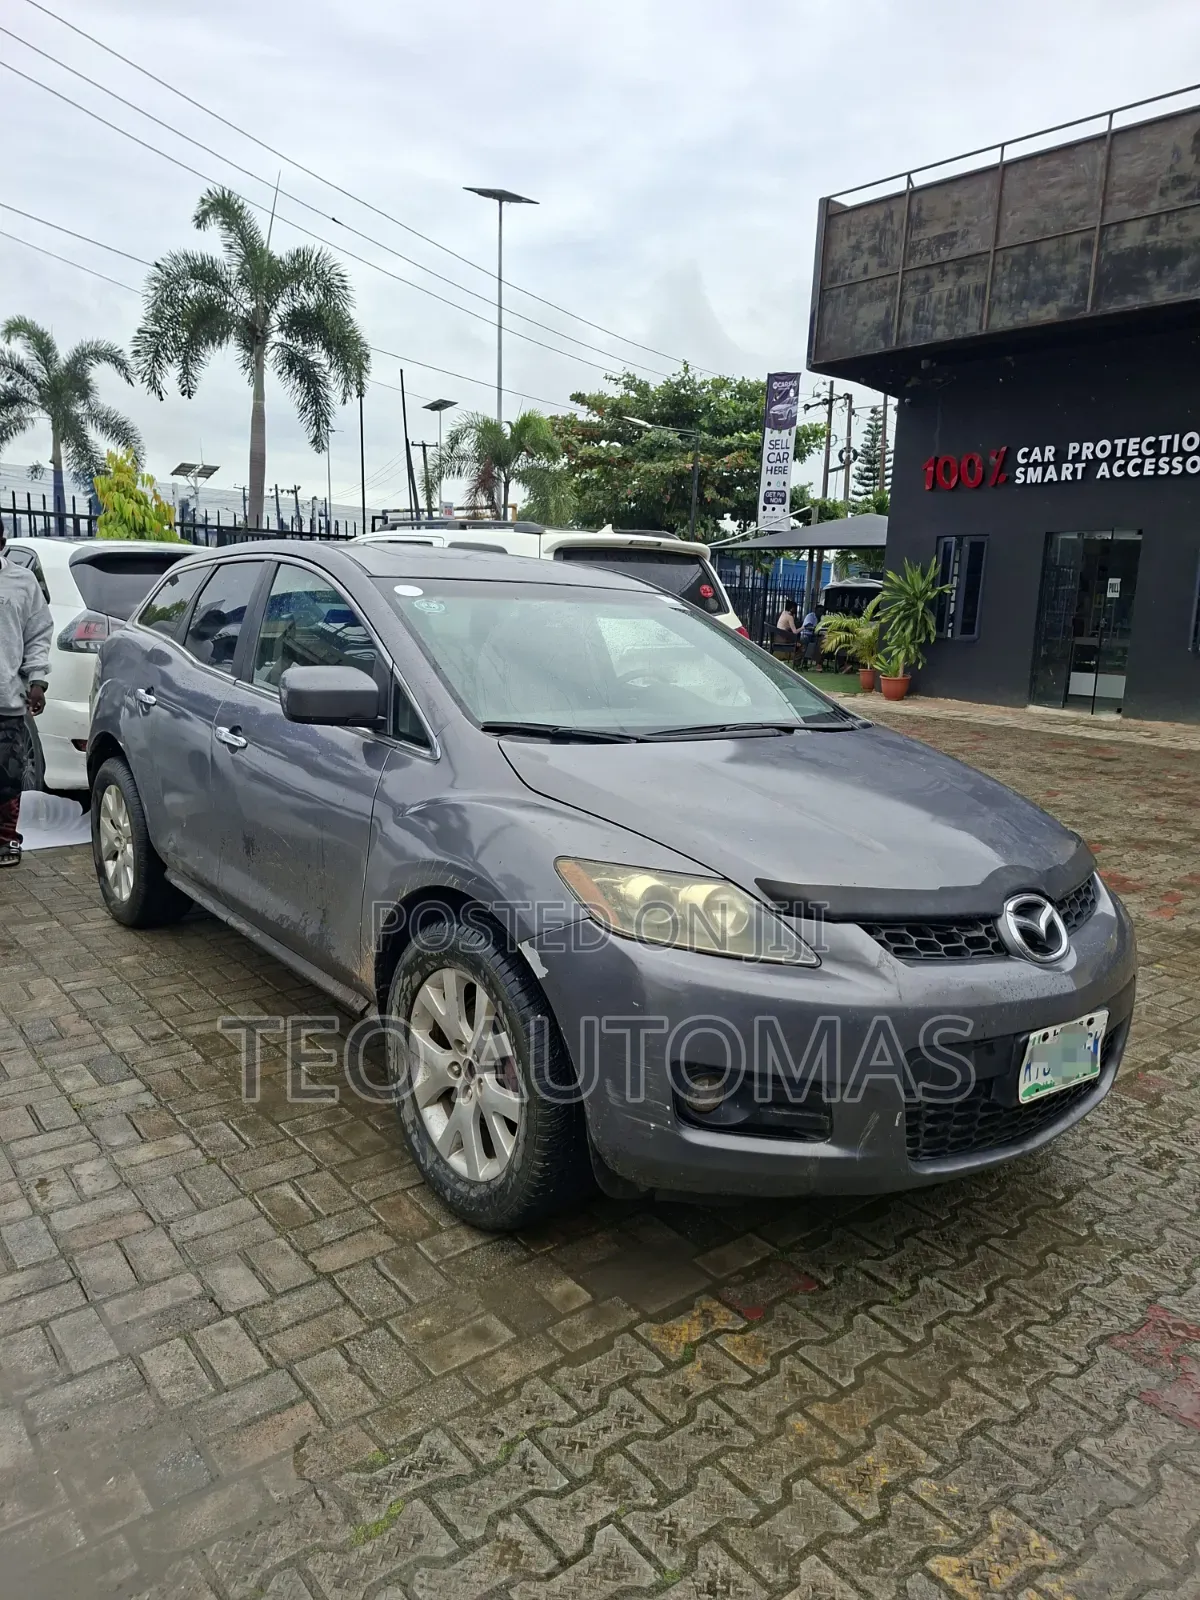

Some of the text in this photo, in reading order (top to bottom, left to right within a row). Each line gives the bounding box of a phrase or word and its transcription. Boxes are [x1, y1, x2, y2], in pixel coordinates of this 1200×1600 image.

[768, 439, 790, 450] SELL
[1016, 431, 1200, 465] CAR PROTECTIO
[767, 452, 790, 464] CAR
[765, 466, 788, 475] HERE
[921, 446, 1009, 491] 100%
[1014, 455, 1200, 485] SMART ACCESSO
[1108, 582, 1118, 593] PULL
